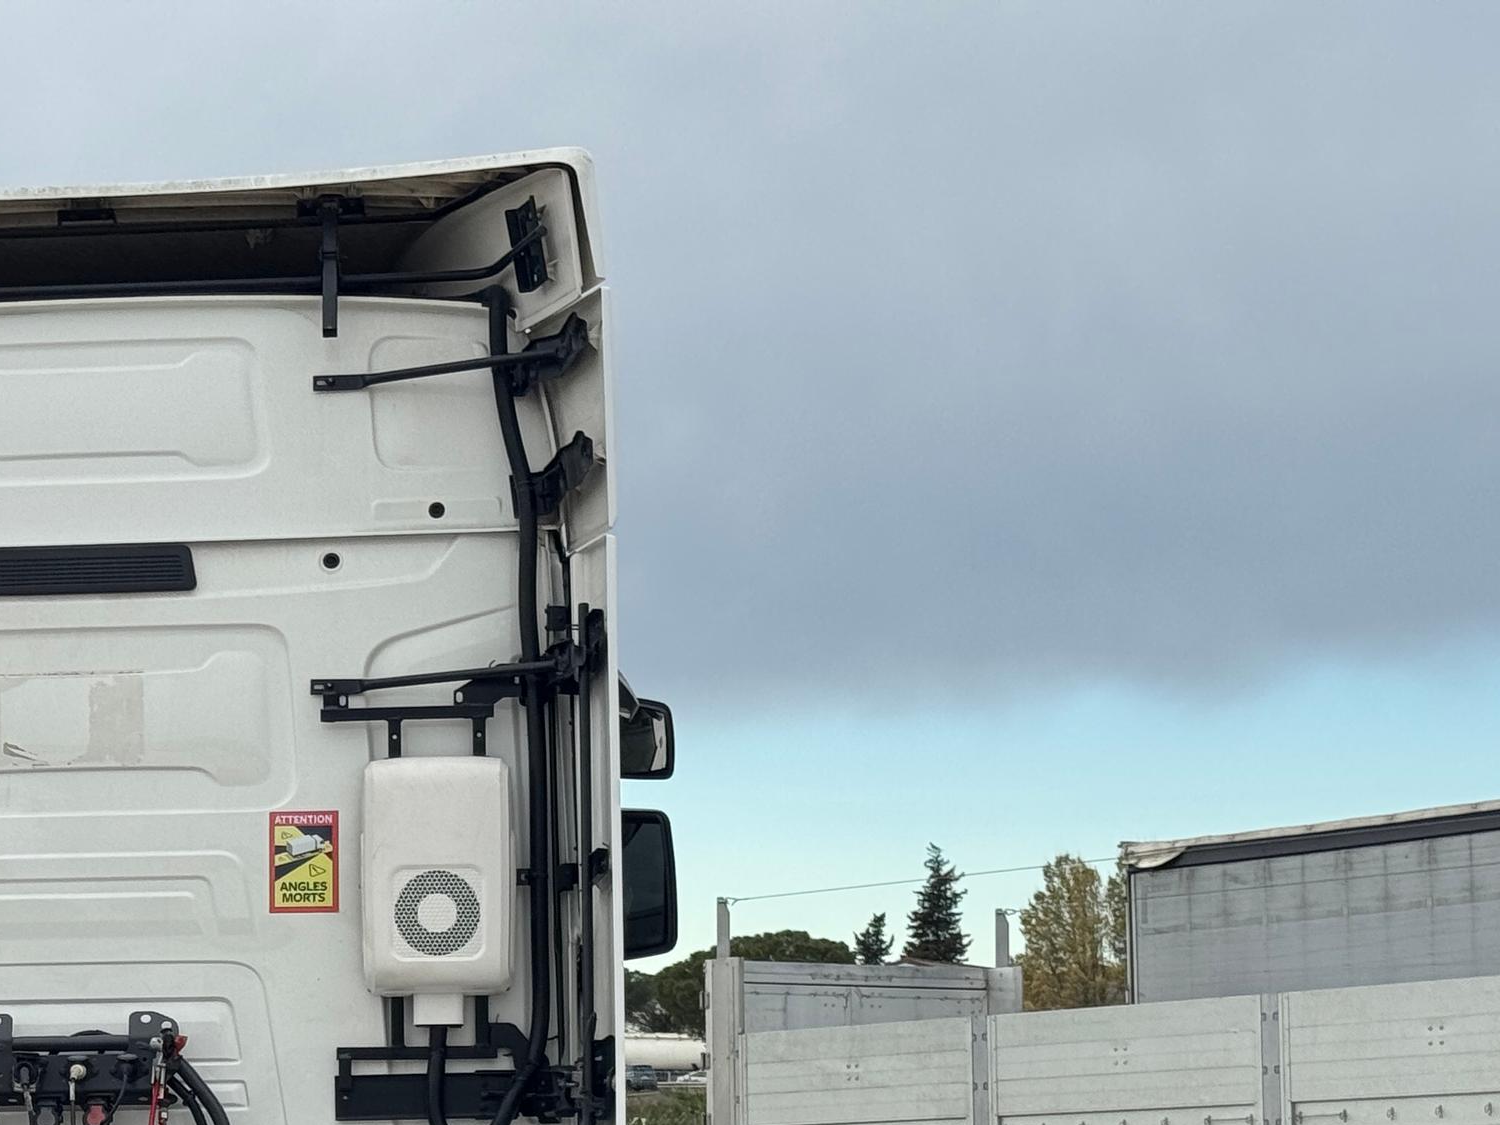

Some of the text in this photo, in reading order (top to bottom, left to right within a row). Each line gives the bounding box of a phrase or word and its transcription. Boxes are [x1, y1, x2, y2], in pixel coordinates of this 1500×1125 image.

[274, 815, 333, 825] ATTENTION
[280, 881, 328, 892] ANGLES
[281, 892, 326, 903] MORTS
